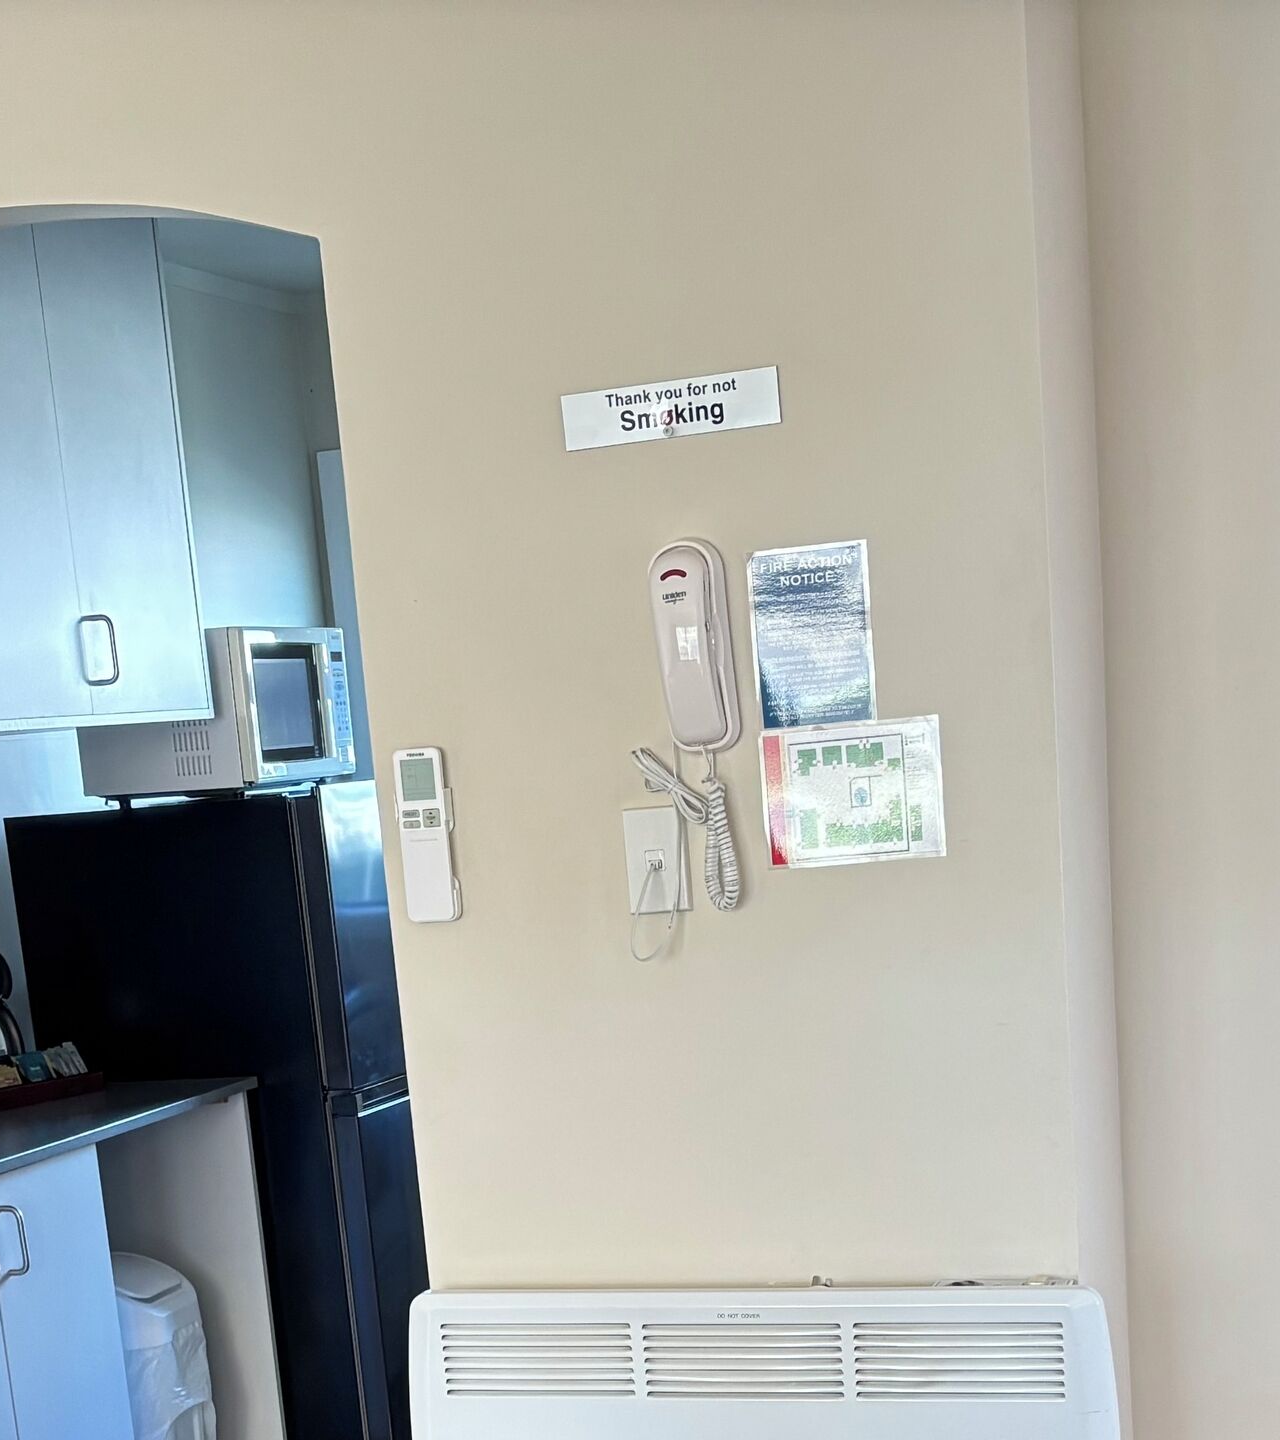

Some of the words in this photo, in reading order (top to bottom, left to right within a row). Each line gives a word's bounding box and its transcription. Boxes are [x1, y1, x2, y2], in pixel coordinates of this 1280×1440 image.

[605, 391, 651, 408] Thank
[656, 386, 683, 404] you
[686, 382, 708, 398] for
[712, 377, 737, 394] not
[620, 402, 724, 431] Smoking
[760, 560, 793, 574] FIRE
[796, 554, 852, 570] ACTION
[780, 570, 834, 587] NOTICE
